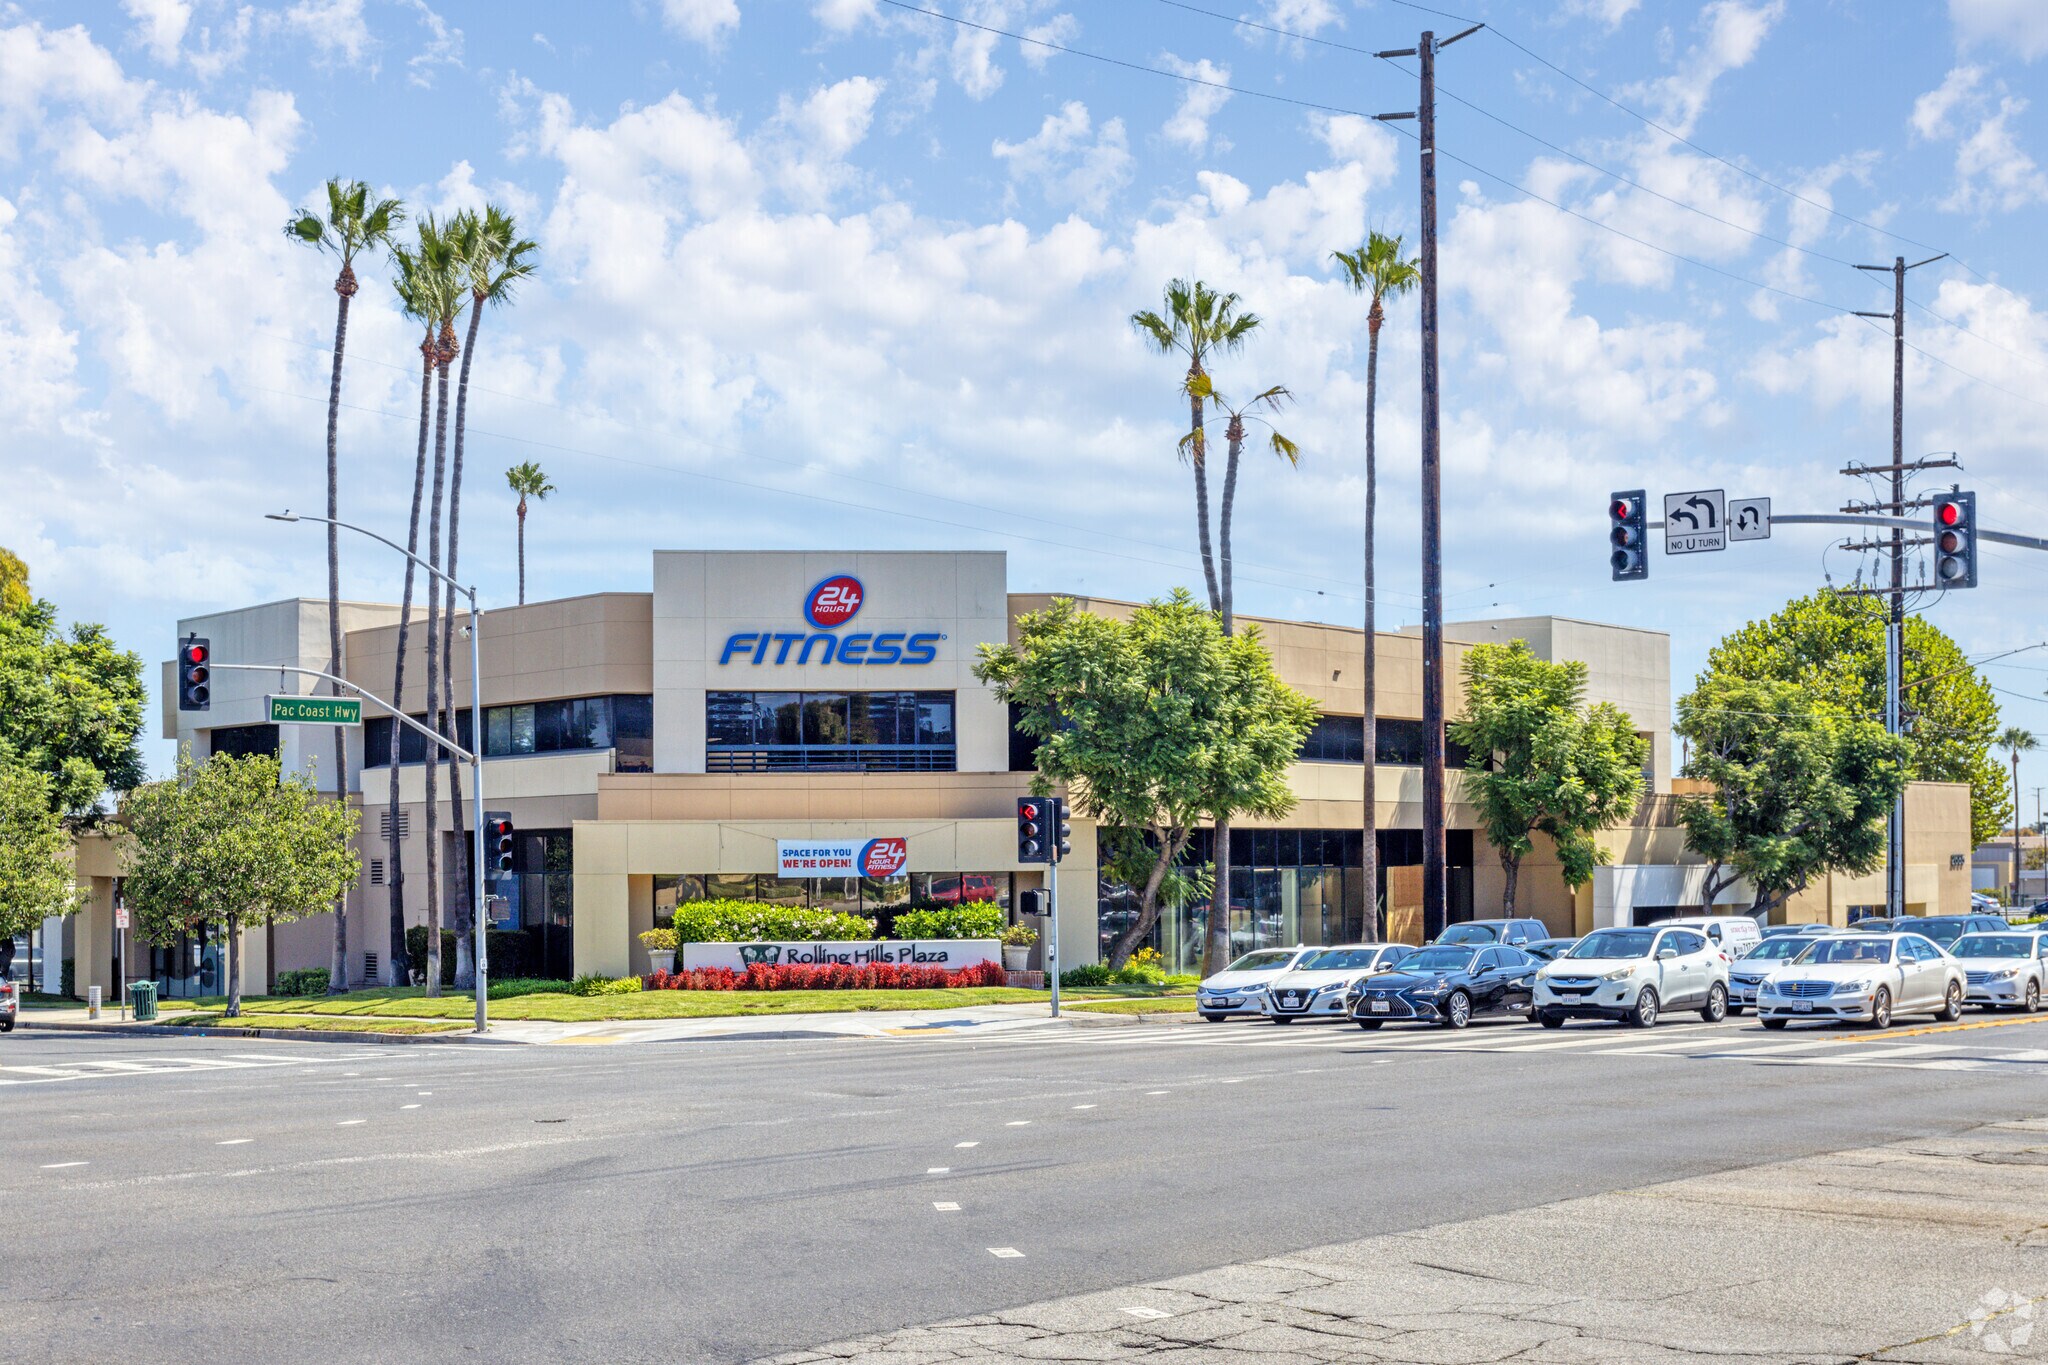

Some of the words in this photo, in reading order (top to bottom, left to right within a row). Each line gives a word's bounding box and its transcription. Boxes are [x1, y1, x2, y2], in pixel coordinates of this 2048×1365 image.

[1671, 540, 1683, 550] NO
[1686, 538, 1696, 550] U
[1698, 537, 1720, 548] TURN
[817, 586, 860, 613] 24
[814, 605, 845, 613] HOUR
[718, 632, 941, 666] FITNESS
[274, 703, 295, 717] Pac
[298, 704, 330, 718] Coast
[334, 705, 358, 722] Hwy
[782, 848, 811, 857] SPACE
[812, 848, 831, 857] FOR
[832, 848, 852, 857] YOU
[870, 842, 906, 864] 24
[782, 859, 817, 868] WE'RE
[819, 858, 852, 868] OPEN!
[866, 863, 897, 871] FITNESS
[787, 944, 851, 966] Rolling
[854, 943, 895, 964] Hills
[898, 943, 949, 964] Plaza
